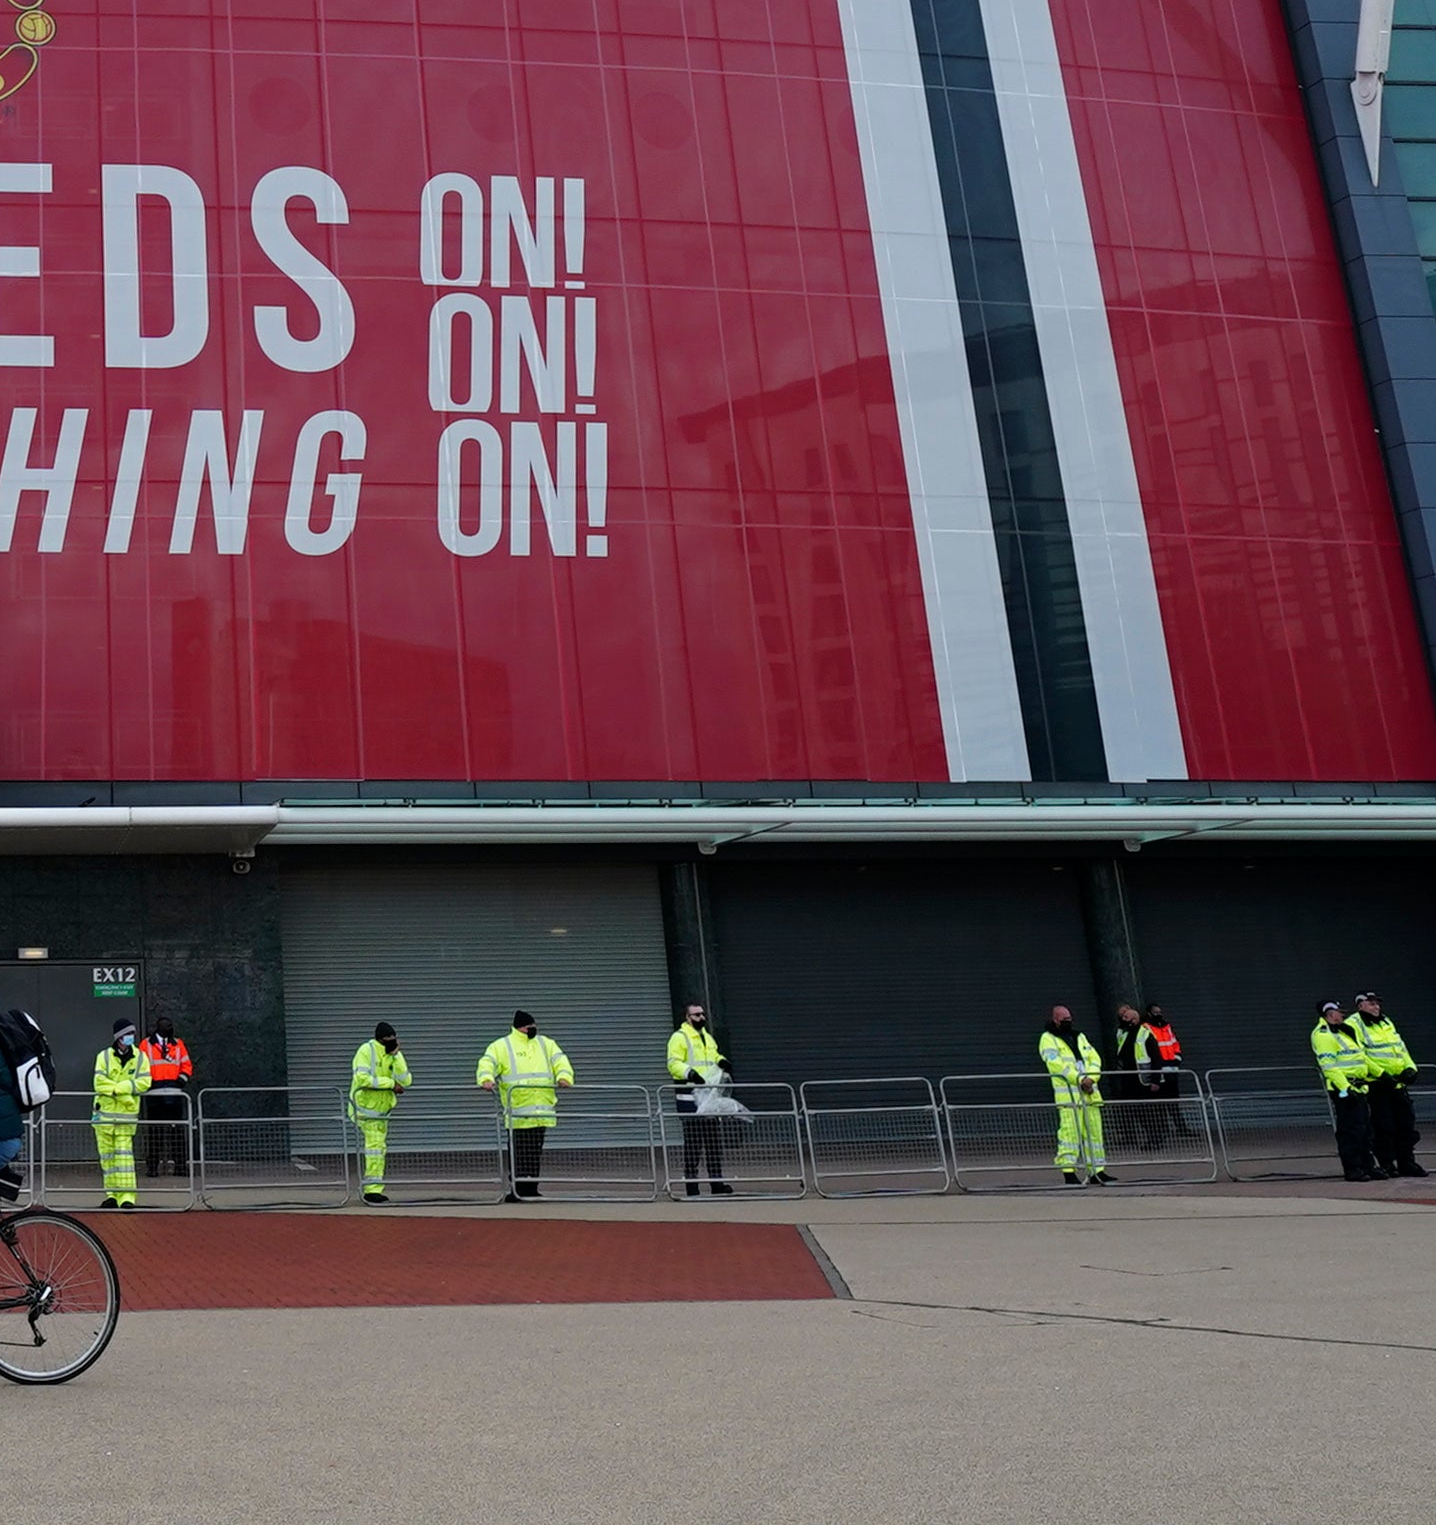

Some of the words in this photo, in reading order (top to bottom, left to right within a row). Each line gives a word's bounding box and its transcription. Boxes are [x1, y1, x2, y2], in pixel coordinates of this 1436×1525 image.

[420, 172, 585, 290] ON!
[428, 292, 597, 415] ON!
[437, 419, 609, 558] ON!
[93, 967, 136, 982] EX12
